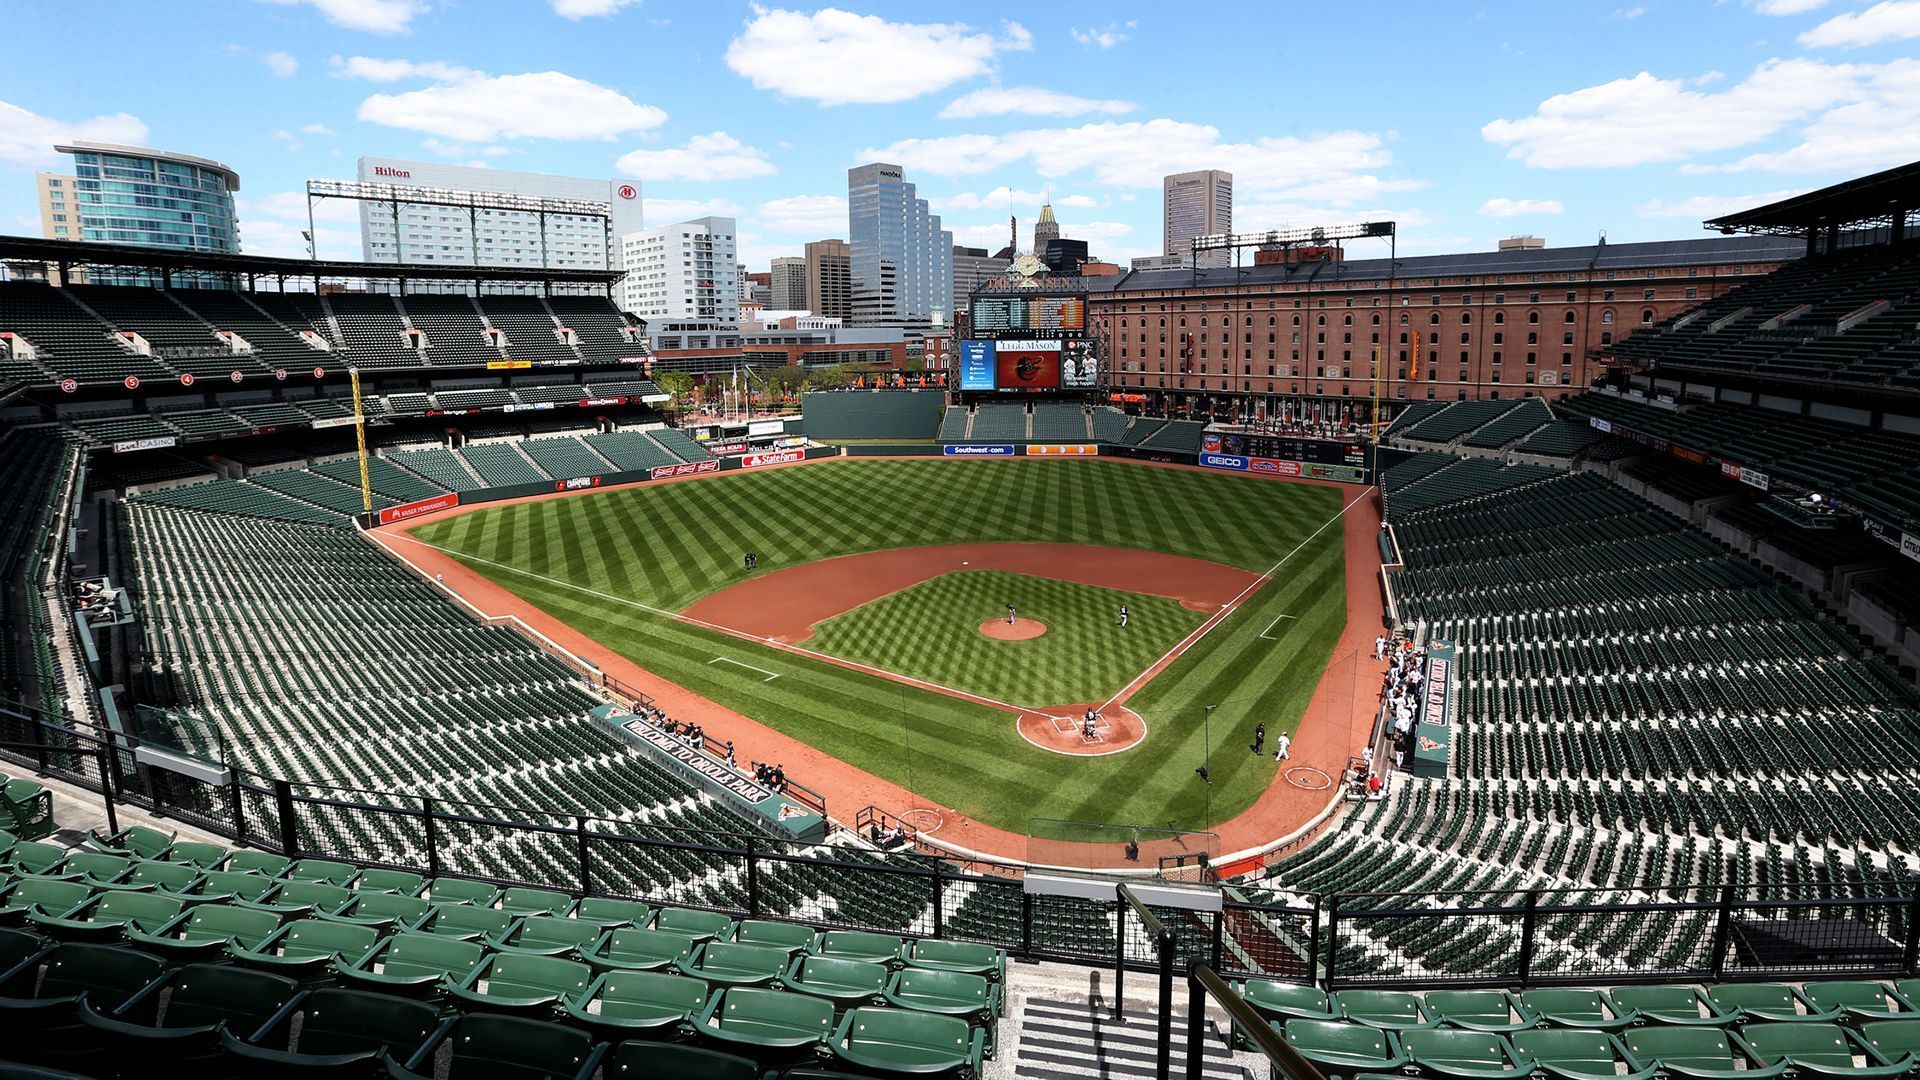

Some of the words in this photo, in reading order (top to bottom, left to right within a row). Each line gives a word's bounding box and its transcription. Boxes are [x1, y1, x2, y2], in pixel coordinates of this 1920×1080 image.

[375, 166, 410, 178] Hilton
[1002, 342, 1024, 350] LEGG
[1026, 341, 1056, 350] MASON
[1077, 341, 1094, 349] PNC
[64, 382, 75, 390] 20
[130, 378, 135, 386] 5
[140, 437, 174, 448] CASINO
[1207, 456, 1241, 467] GEICO
[401, 508, 417, 517] KAISER
[626, 720, 679, 751] WELCOME
[671, 746, 694, 760] TO
[688, 756, 735, 784] ORIOLE
[727, 780, 769, 803] PARK
